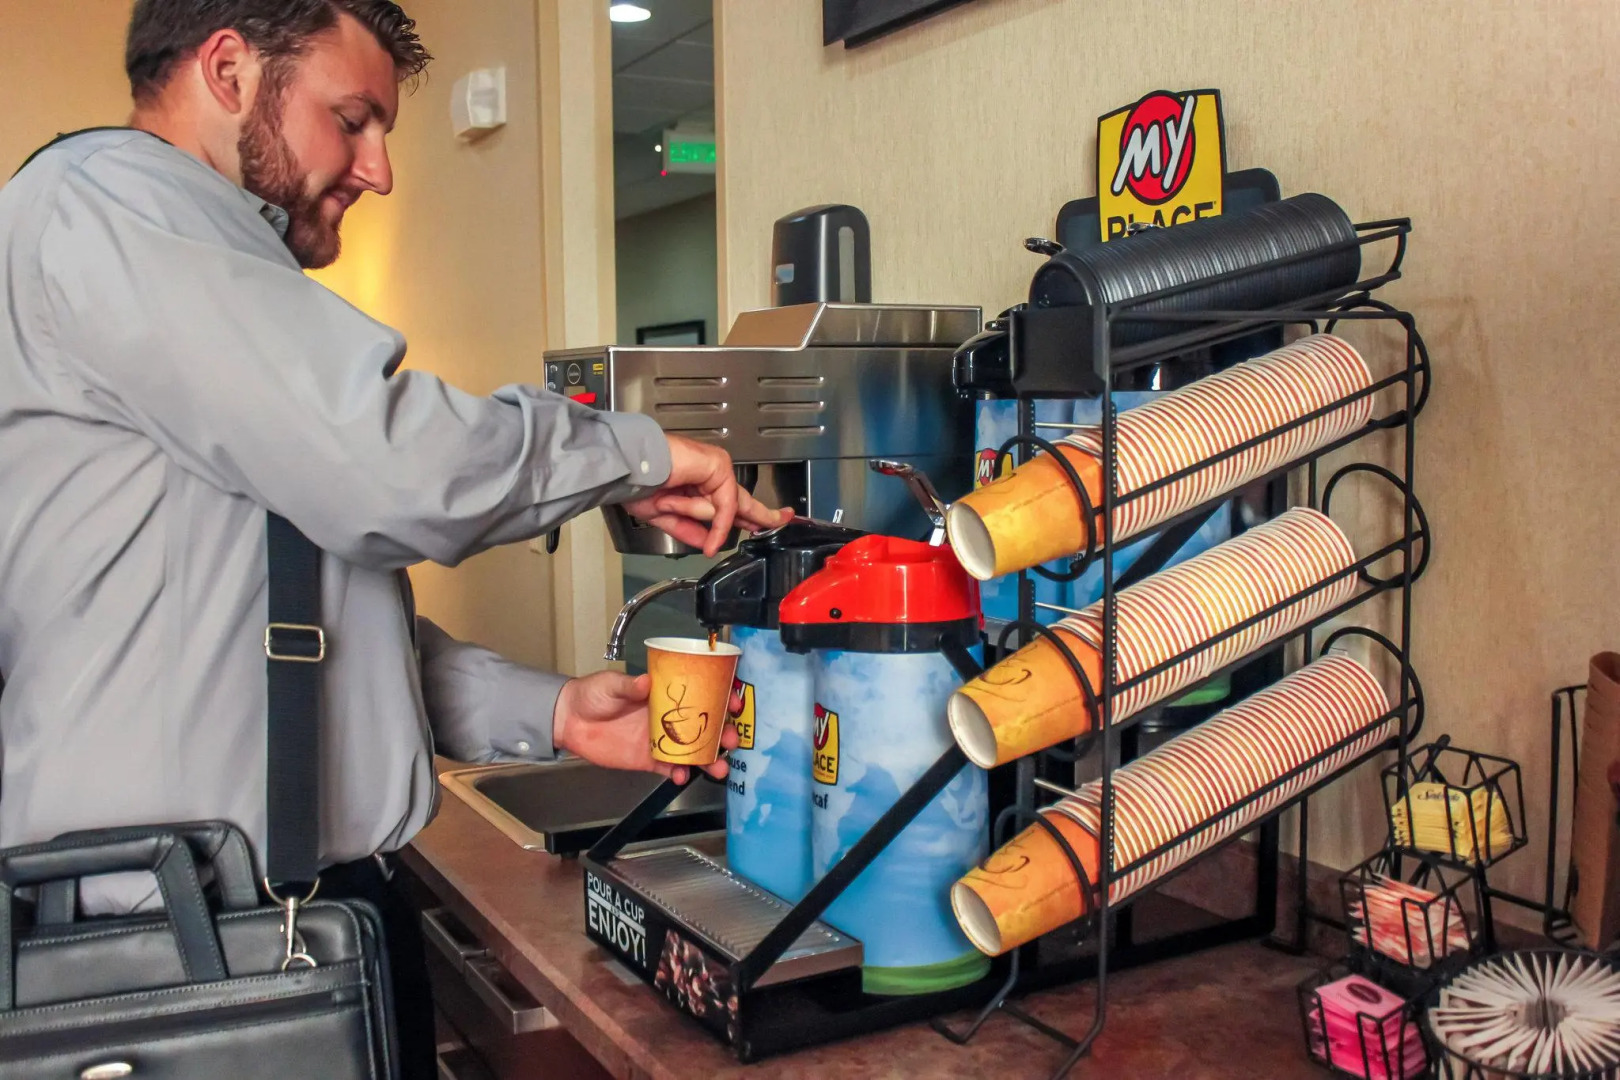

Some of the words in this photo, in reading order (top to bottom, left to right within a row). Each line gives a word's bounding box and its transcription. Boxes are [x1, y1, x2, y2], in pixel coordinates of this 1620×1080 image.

[587, 872, 612, 903] POUR
[615, 891, 622, 911] A
[624, 898, 645, 924] CUP
[588, 898, 647, 968] ENJOY!
